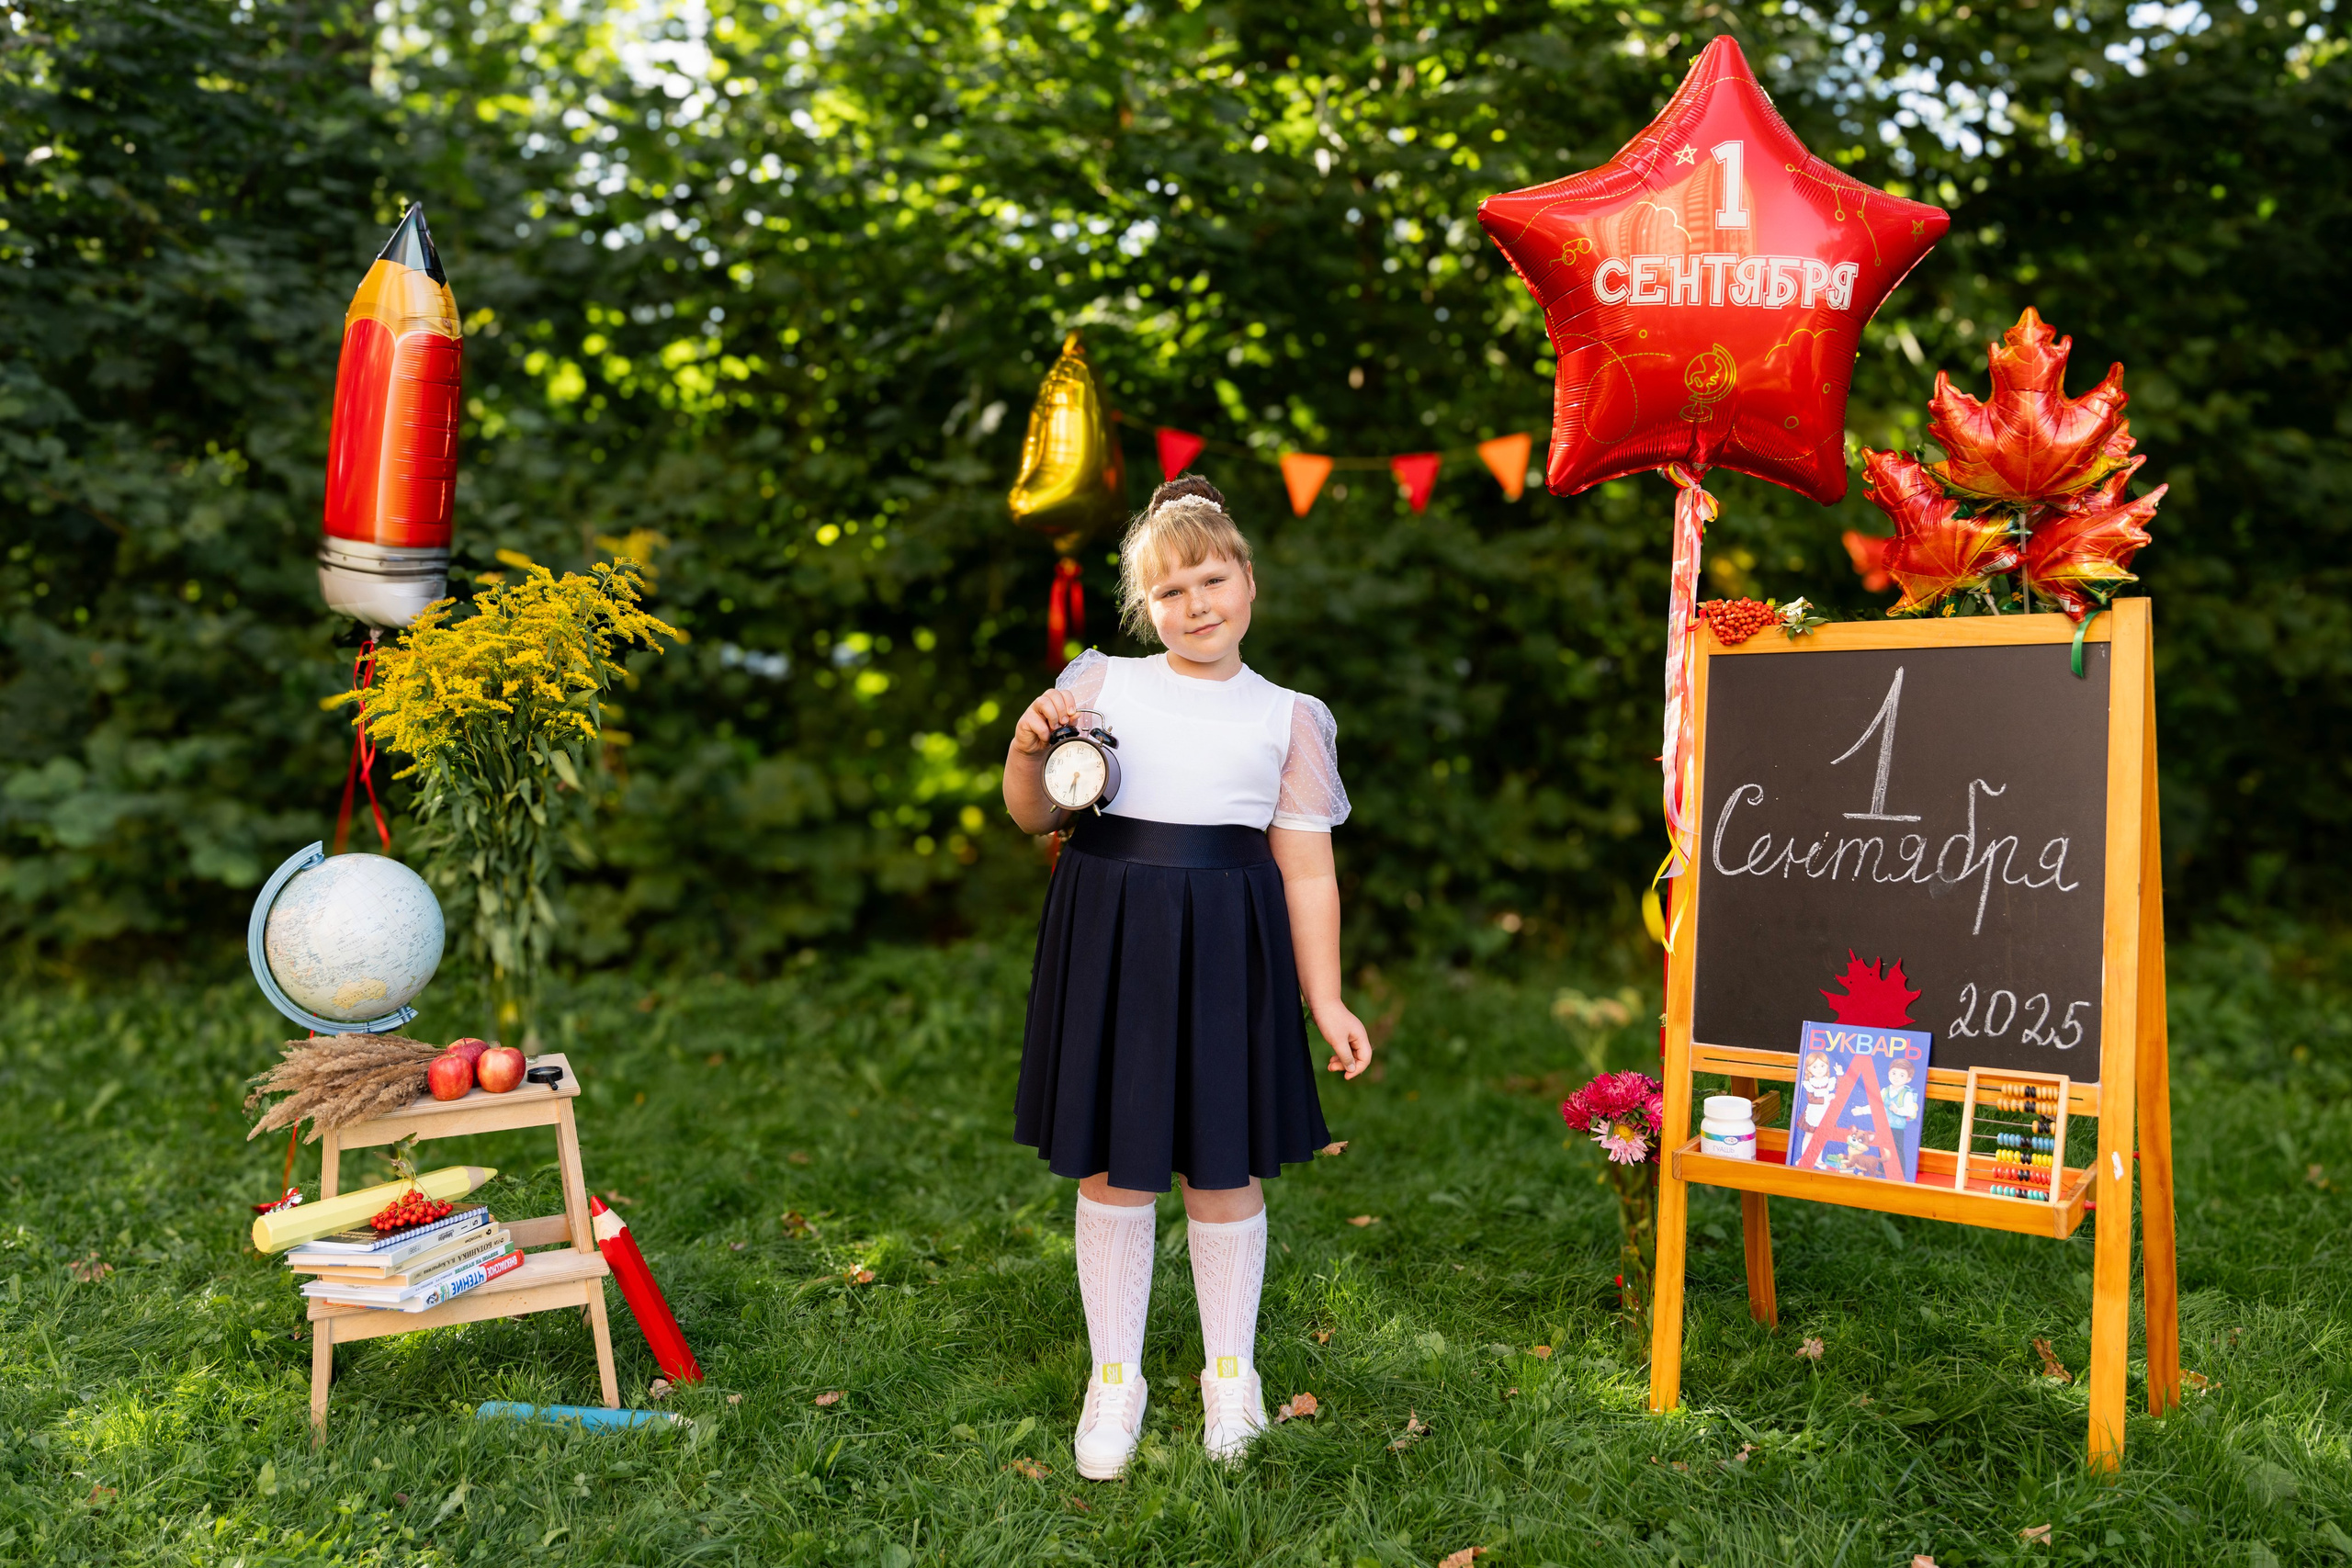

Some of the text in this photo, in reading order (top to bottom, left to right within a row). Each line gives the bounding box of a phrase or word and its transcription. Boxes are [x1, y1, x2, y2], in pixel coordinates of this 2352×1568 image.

[1710, 141, 1749, 230] 1
[1592, 252, 1859, 310] СЕНТЯБРЯ
[1830, 666, 1921, 821] 1
[1713, 779, 2079, 935] Сентября
[1947, 982, 2092, 1049] 2025
[1808, 1029, 1922, 1061] БУКВАРЬ
[1797, 1054, 1906, 1182] А
[1713, 1145, 1736, 1154] ГУАШЬ
[458, 1241, 492, 1261] БОТАНИКА
[487, 1255, 518, 1278] ВНЕКЛАССНОЕ
[451, 1270, 485, 1296] ЧТЕНИЕ
[1106, 1366, 1119, 1382] SH
[1222, 1358, 1234, 1374] SH
